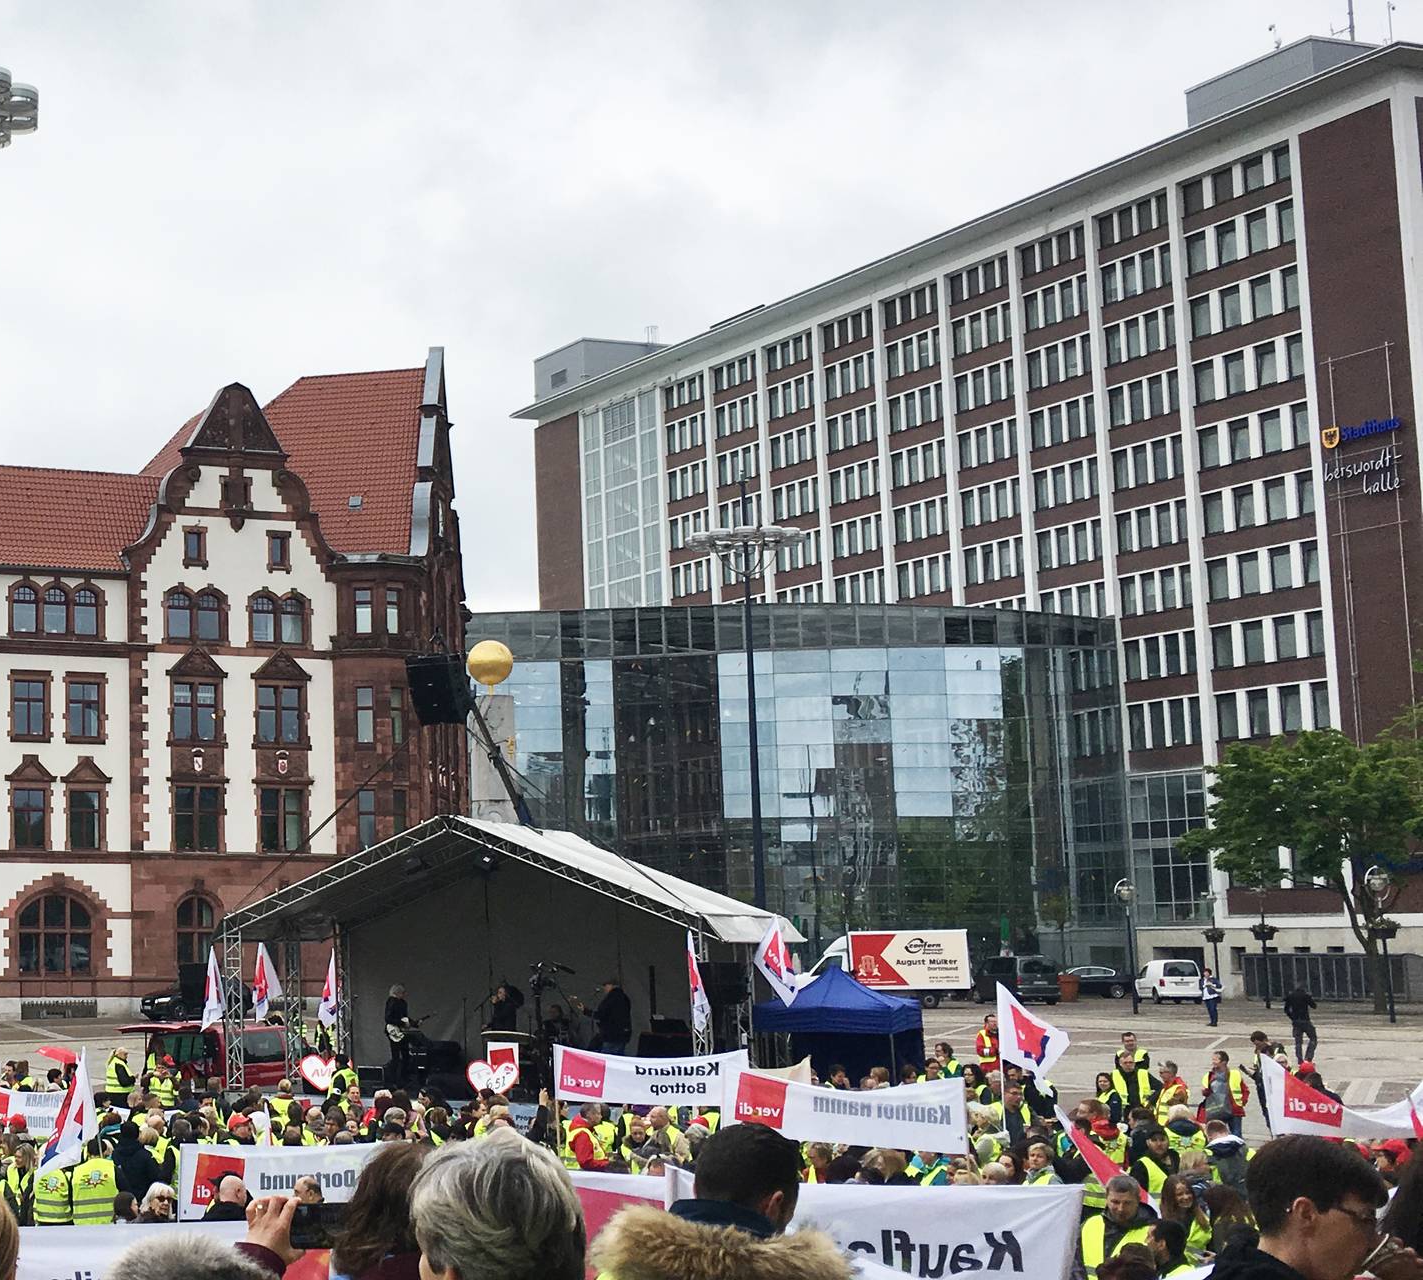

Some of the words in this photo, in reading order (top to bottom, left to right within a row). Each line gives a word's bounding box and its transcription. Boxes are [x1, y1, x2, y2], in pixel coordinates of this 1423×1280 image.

[1341, 418, 1400, 441] Stadthaus
[1363, 471, 1400, 495] halle
[896, 959, 926, 967] August
